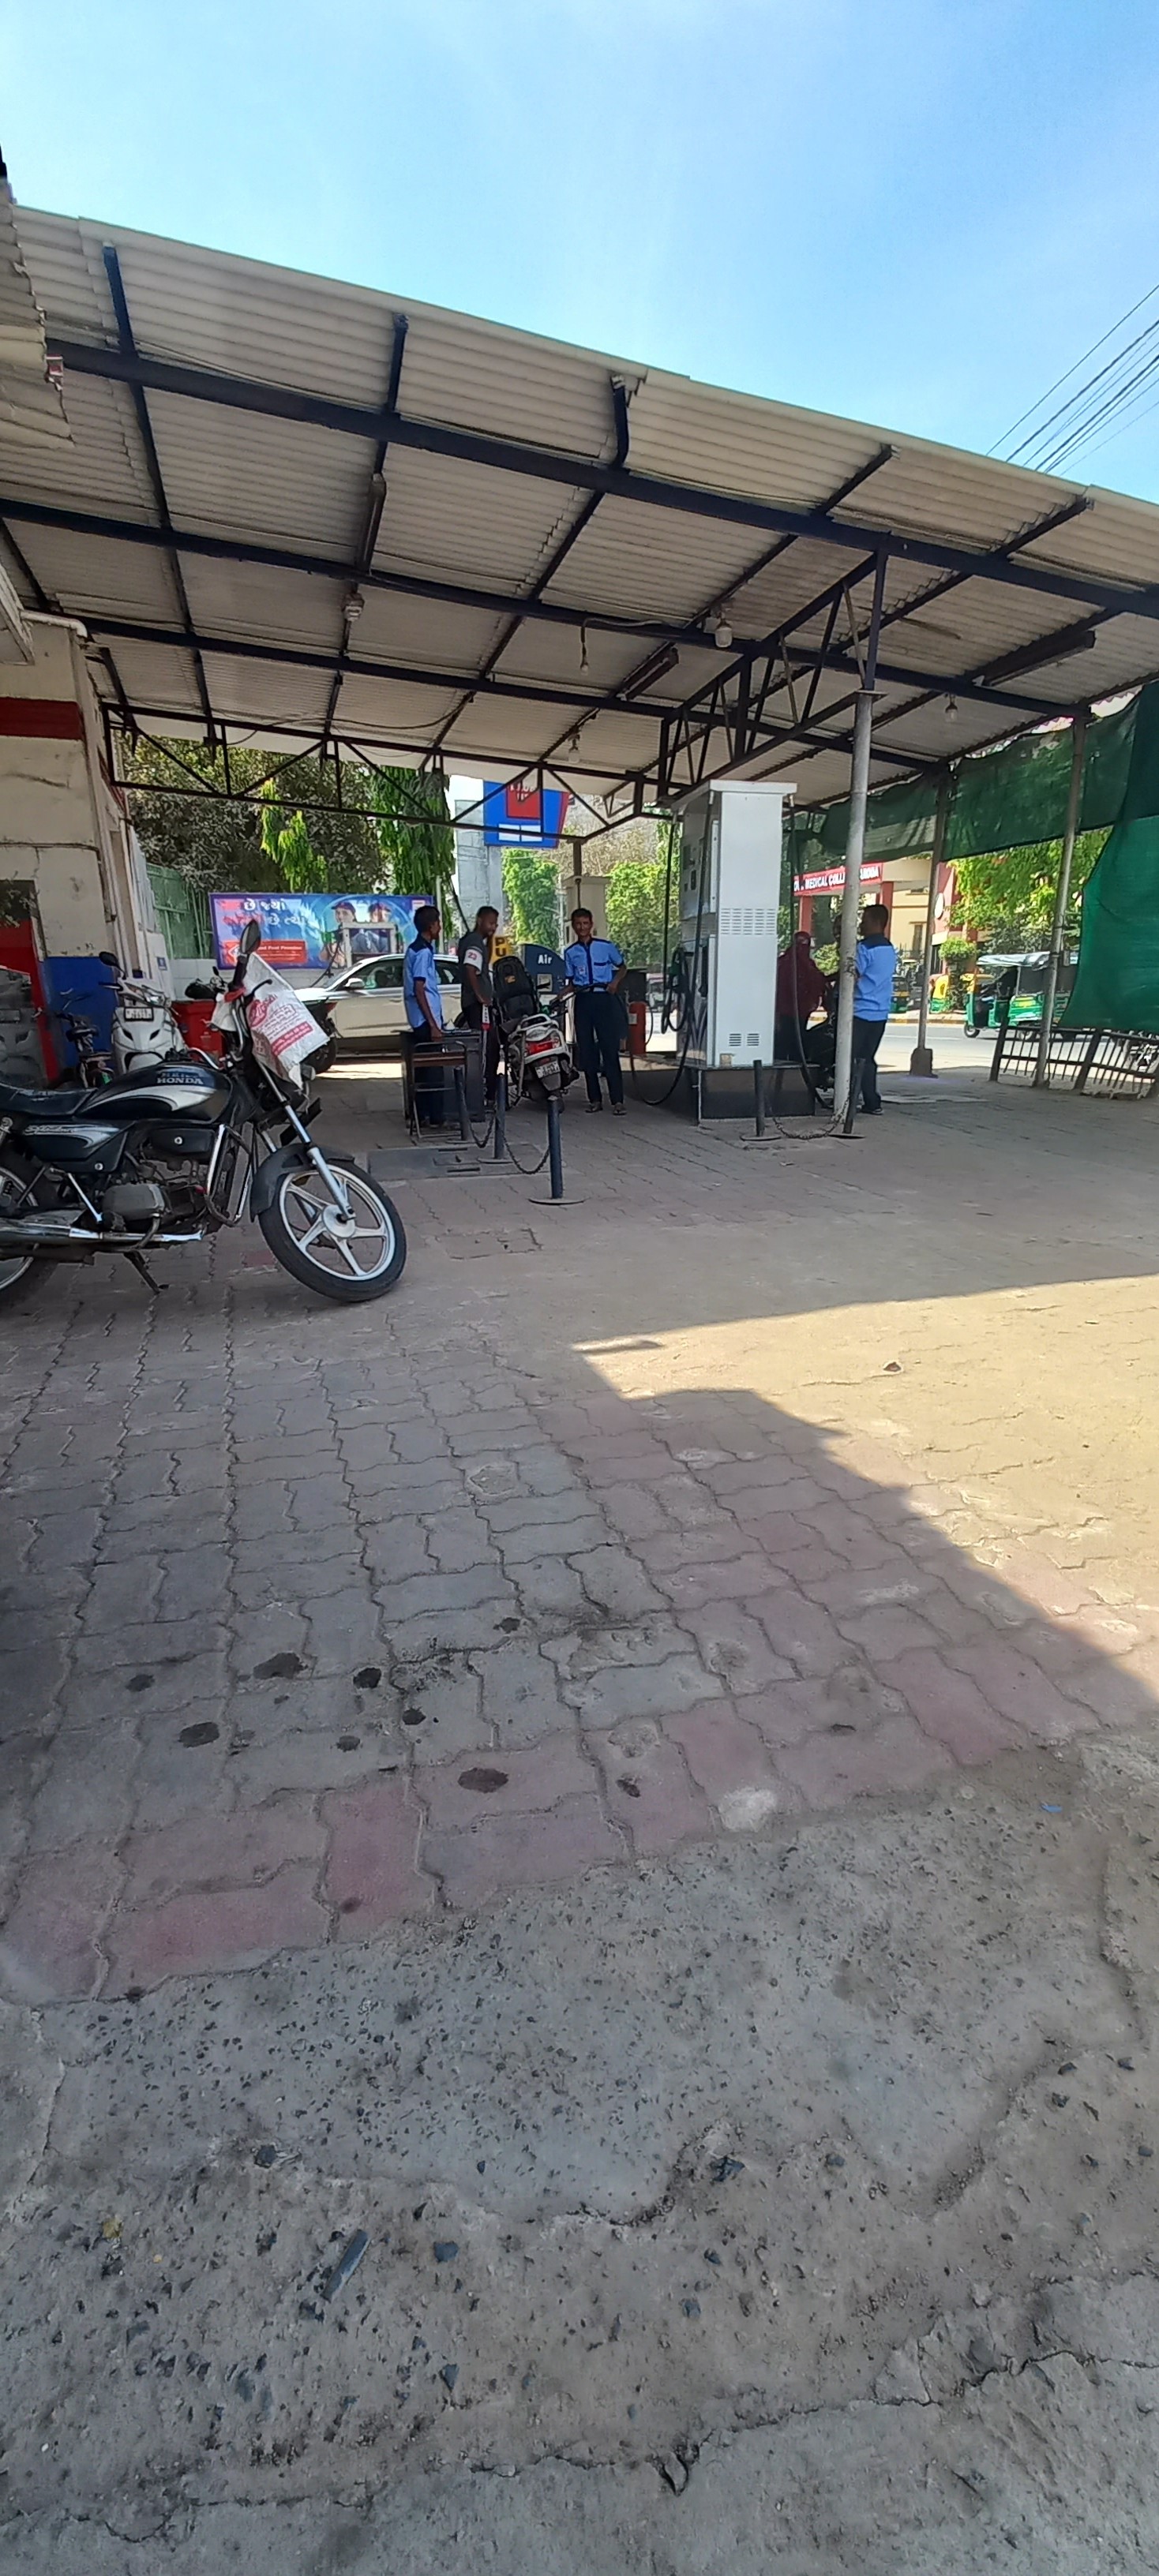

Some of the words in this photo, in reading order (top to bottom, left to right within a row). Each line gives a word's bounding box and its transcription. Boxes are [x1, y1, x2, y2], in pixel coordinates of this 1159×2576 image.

[805, 876, 828, 889] MEDICAL
[828, 872, 846, 886] COLL
[538, 954, 553, 964] Air
